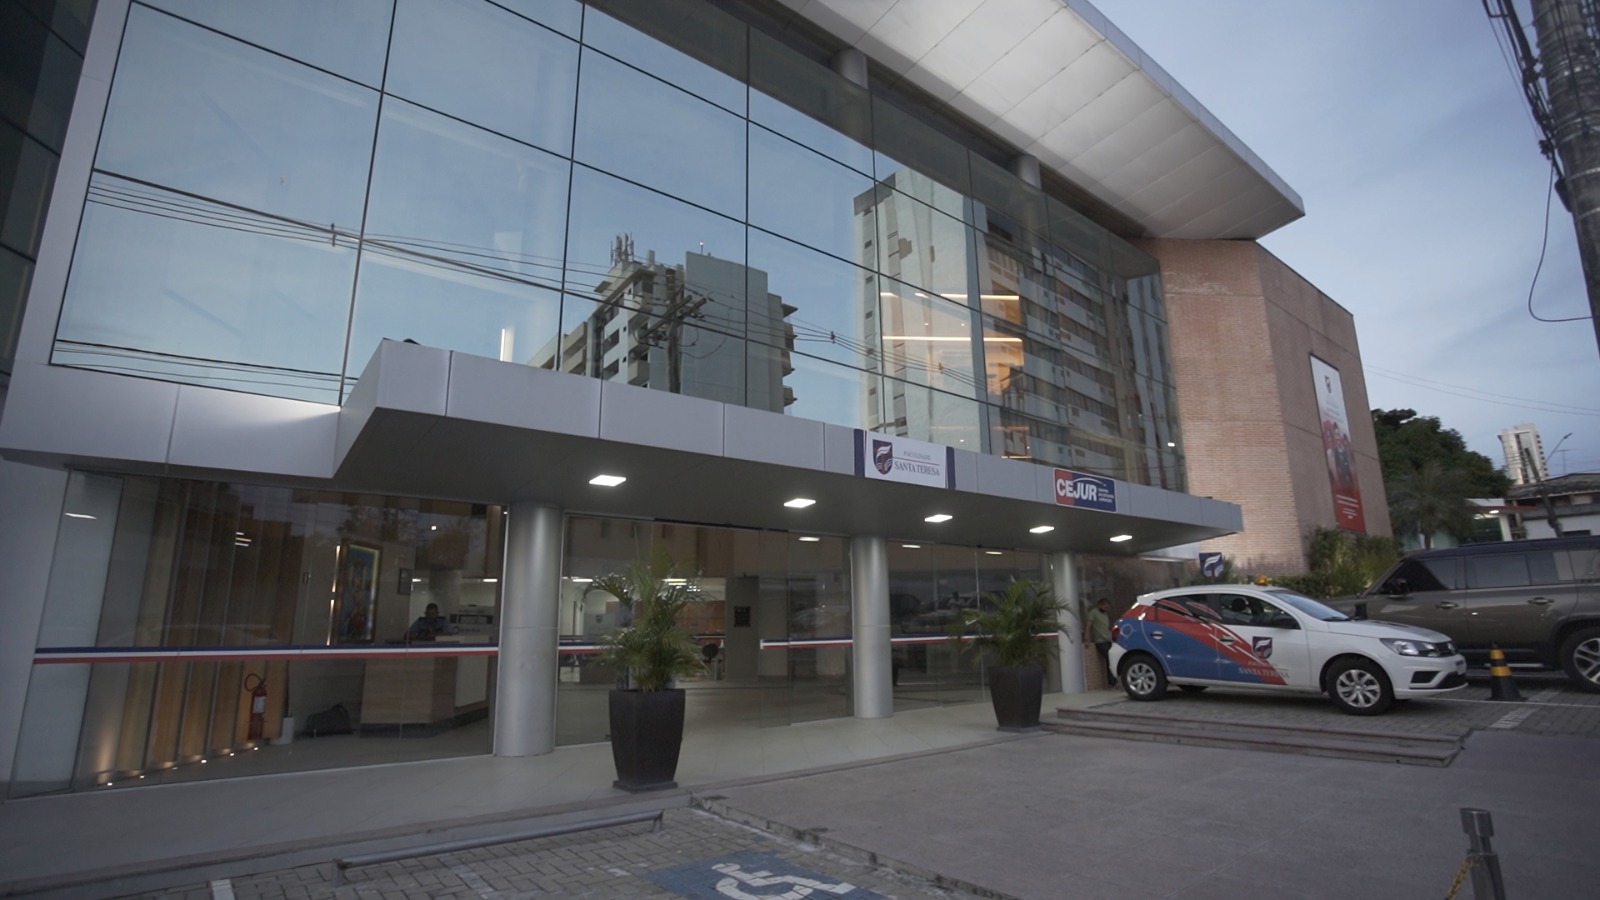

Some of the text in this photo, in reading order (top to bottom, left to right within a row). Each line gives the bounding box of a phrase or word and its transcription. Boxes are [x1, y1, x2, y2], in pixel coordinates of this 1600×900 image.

[894, 461, 940, 476] SANTA TERESA
[1056, 478, 1097, 502] CEJUR
